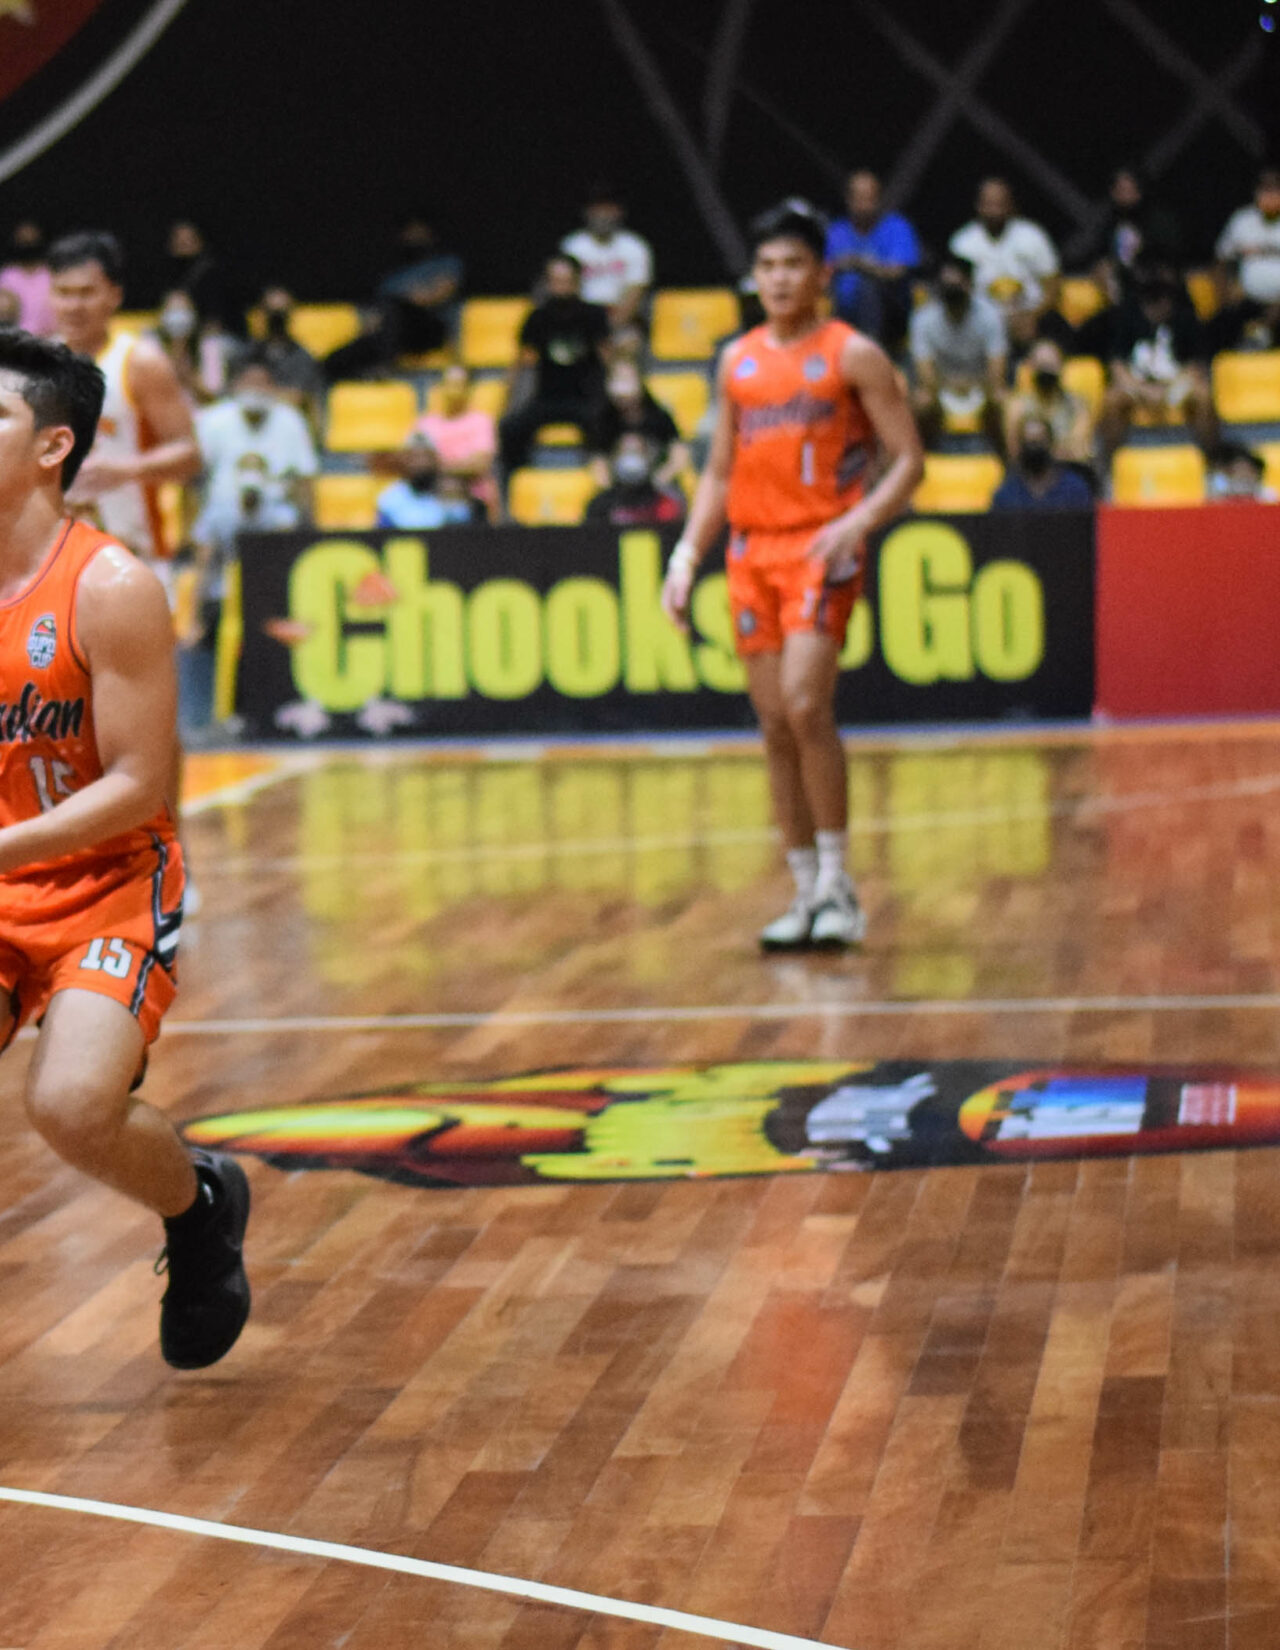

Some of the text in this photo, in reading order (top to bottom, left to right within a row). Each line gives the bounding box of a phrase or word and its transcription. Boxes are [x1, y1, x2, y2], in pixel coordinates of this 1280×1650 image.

[288, 529, 750, 713] Chooks
[877, 519, 1046, 686] Go
[79, 937, 133, 979] 15
